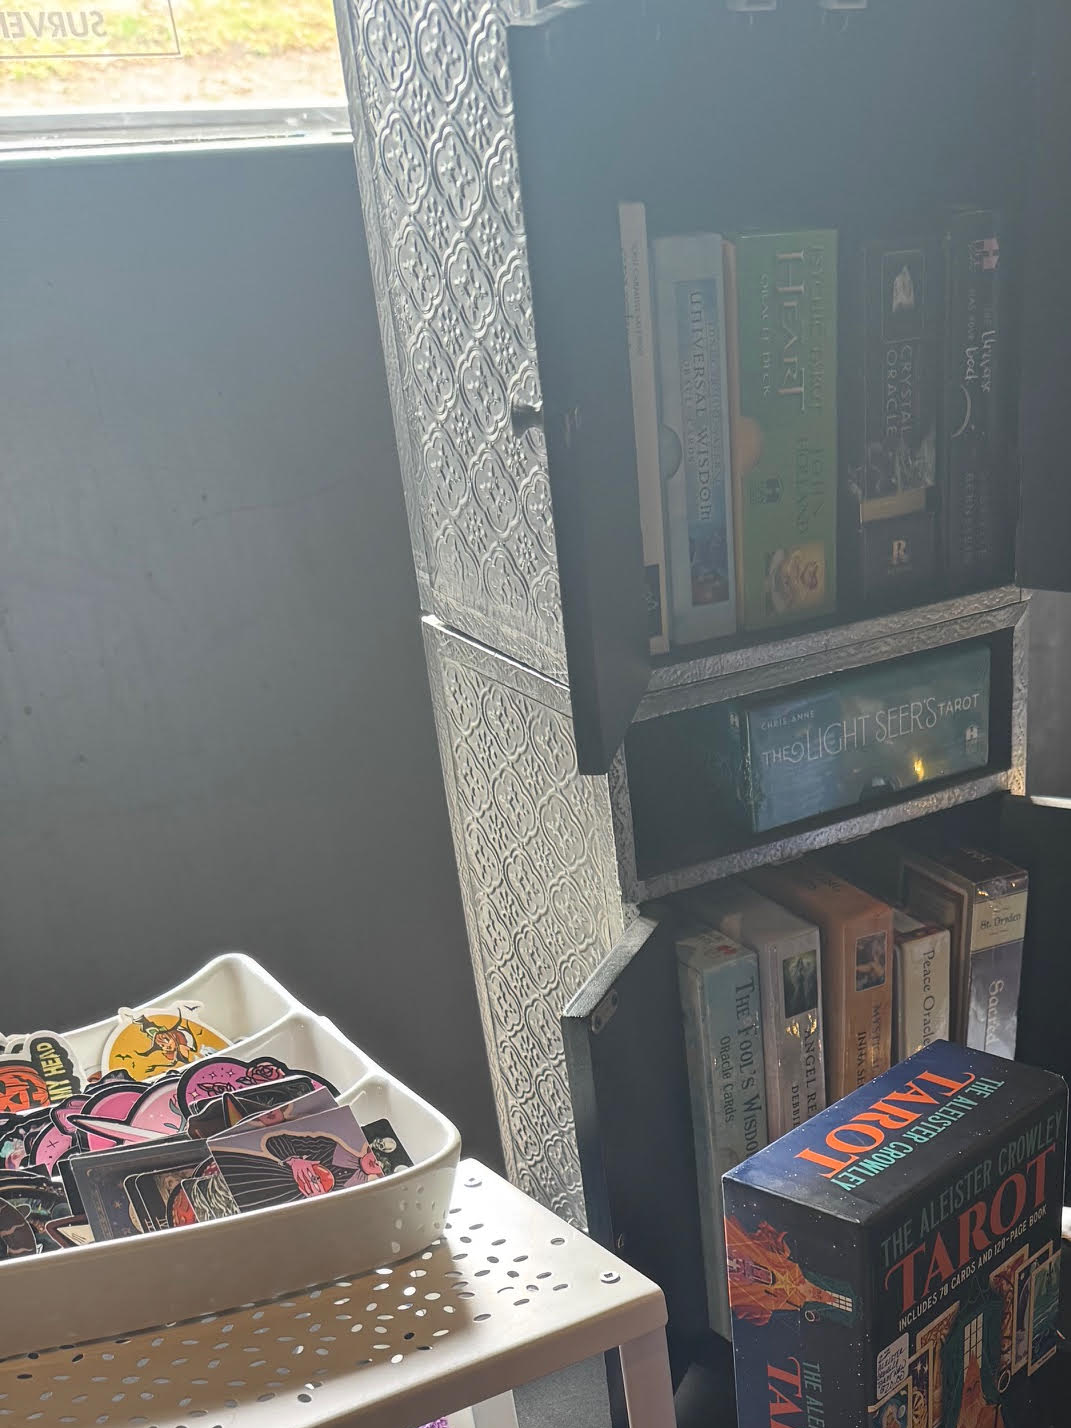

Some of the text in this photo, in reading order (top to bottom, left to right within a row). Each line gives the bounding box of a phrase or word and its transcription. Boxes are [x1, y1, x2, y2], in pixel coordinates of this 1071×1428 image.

[776, 247, 807, 416] HEART
[689, 290, 712, 521] UNIVERSAL WISDOM
[885, 348, 899, 438] ORACLE
[899, 344, 913, 436] CRYSTAL
[761, 693, 981, 767] THE LIGHT SEER'S TAROT
[922, 949, 936, 1047] Peace Oracle
[38, 1041, 73, 1103] MY HEAD
[735, 977, 763, 1156] THE FOOL'S WISDO
[803, 1029, 816, 1088] ANGEL
[794, 1069, 977, 1180] TAROT
[829, 1076, 1005, 1192] THE ALEISTER CROWLEY
[880, 1109, 1065, 1267] THE ALEISTER CROWLEY
[883, 1144, 1057, 1313] TAROT
[898, 1291, 938, 1333] INCLUDES
[951, 1262, 976, 1290] CARDS
[976, 1247, 993, 1269] AND
[1028, 1203, 1048, 1229] BOOK
[802, 1360, 823, 1393] THE
